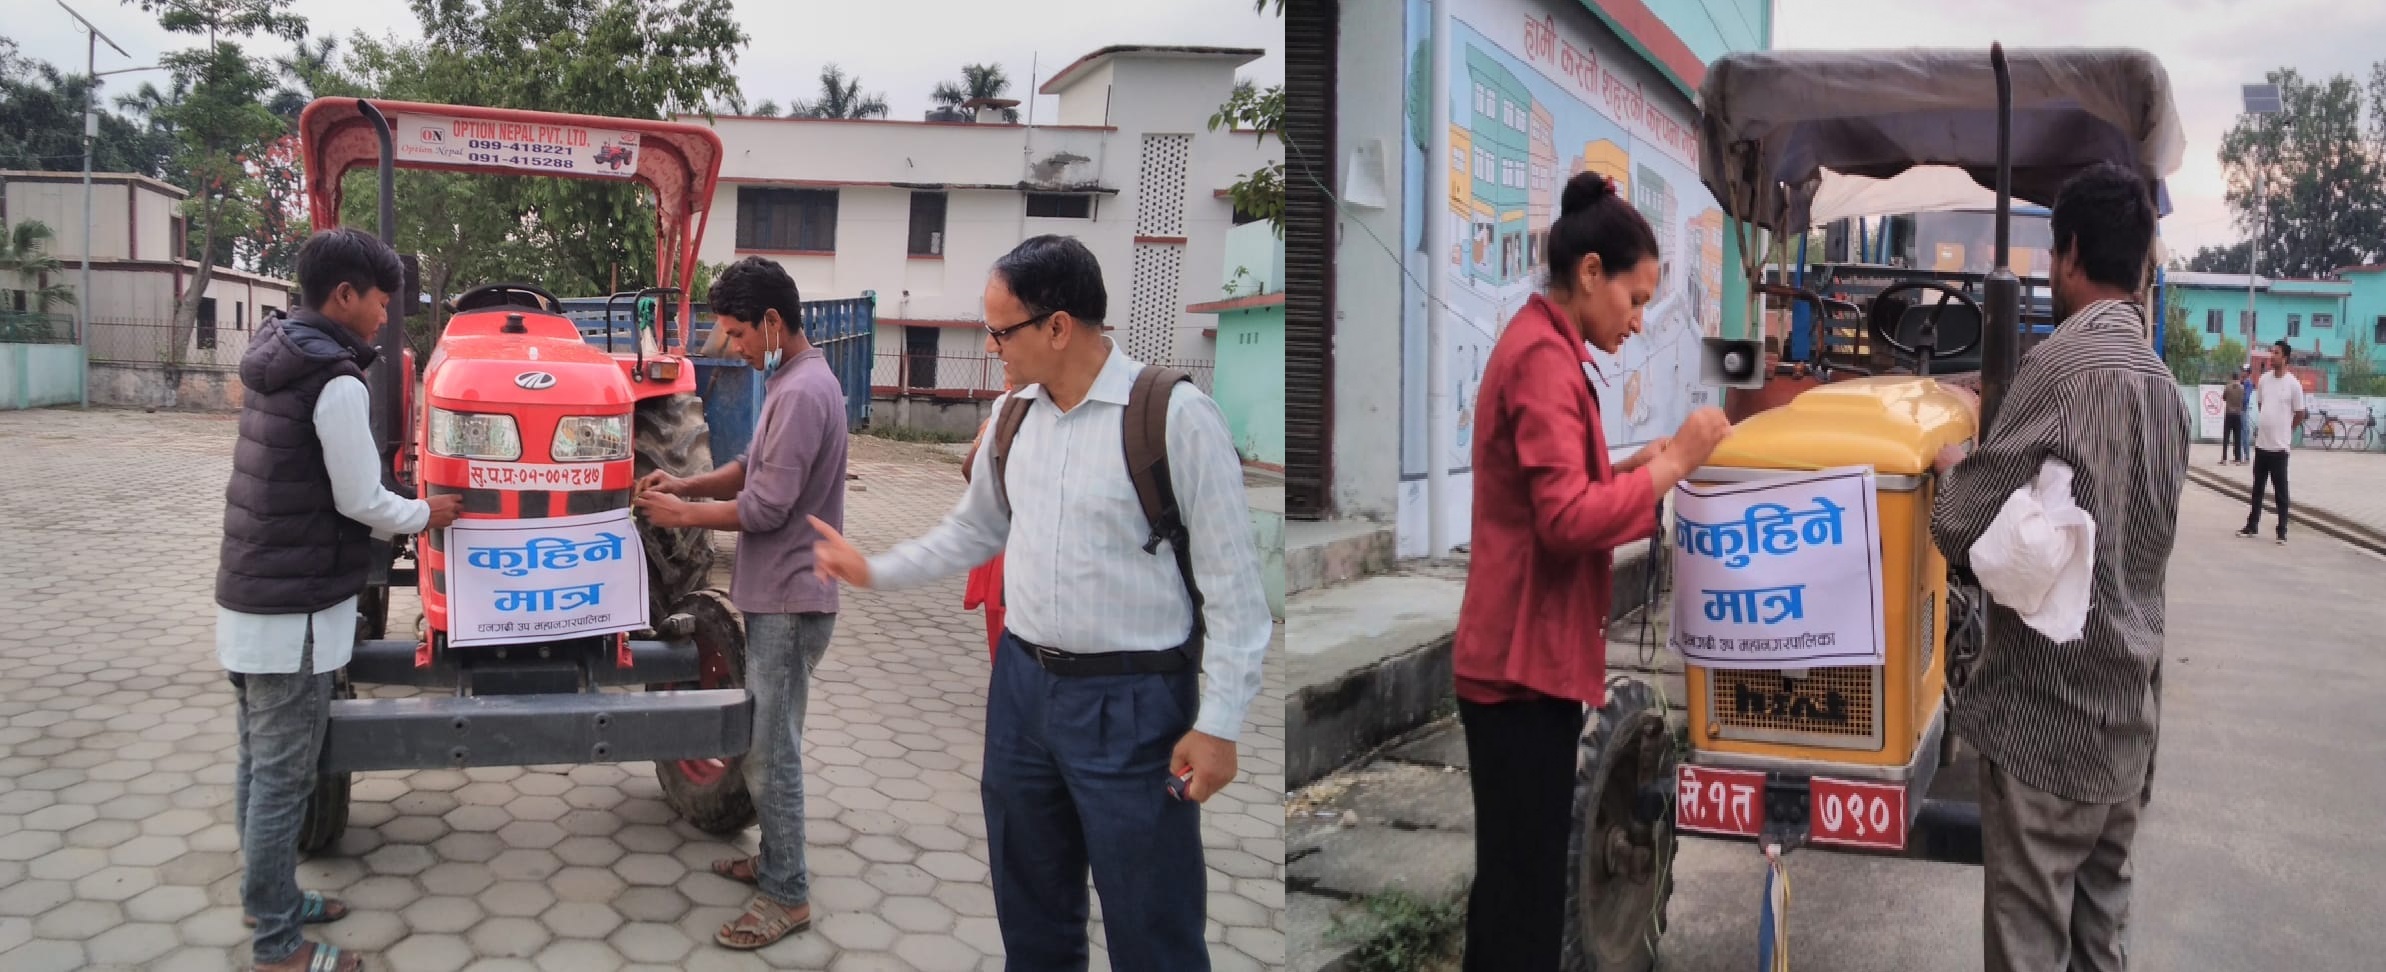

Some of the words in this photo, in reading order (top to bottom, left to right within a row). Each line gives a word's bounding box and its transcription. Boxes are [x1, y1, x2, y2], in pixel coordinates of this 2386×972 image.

[1524, 13, 1557, 66] हामी
[422, 131, 443, 143] ON
[453, 120, 496, 140] OPTION
[499, 121, 534, 143] NEPAL
[538, 124, 564, 145] PVT.
[567, 129, 591, 147] LTD.
[401, 145, 433, 157] Option
[435, 145, 464, 157] Nepal
[468, 139, 573, 156] 099-418221
[468, 152, 574, 169] 091-415288
[467, 532, 626, 577] कुहिने
[493, 582, 605, 612] मात्र
[1701, 584, 1806, 625] मात्र
[517, 622, 530, 632] उप
[534, 613, 611, 630] महानगरपालिका
[1818, 792, 1890, 836] ७९०
